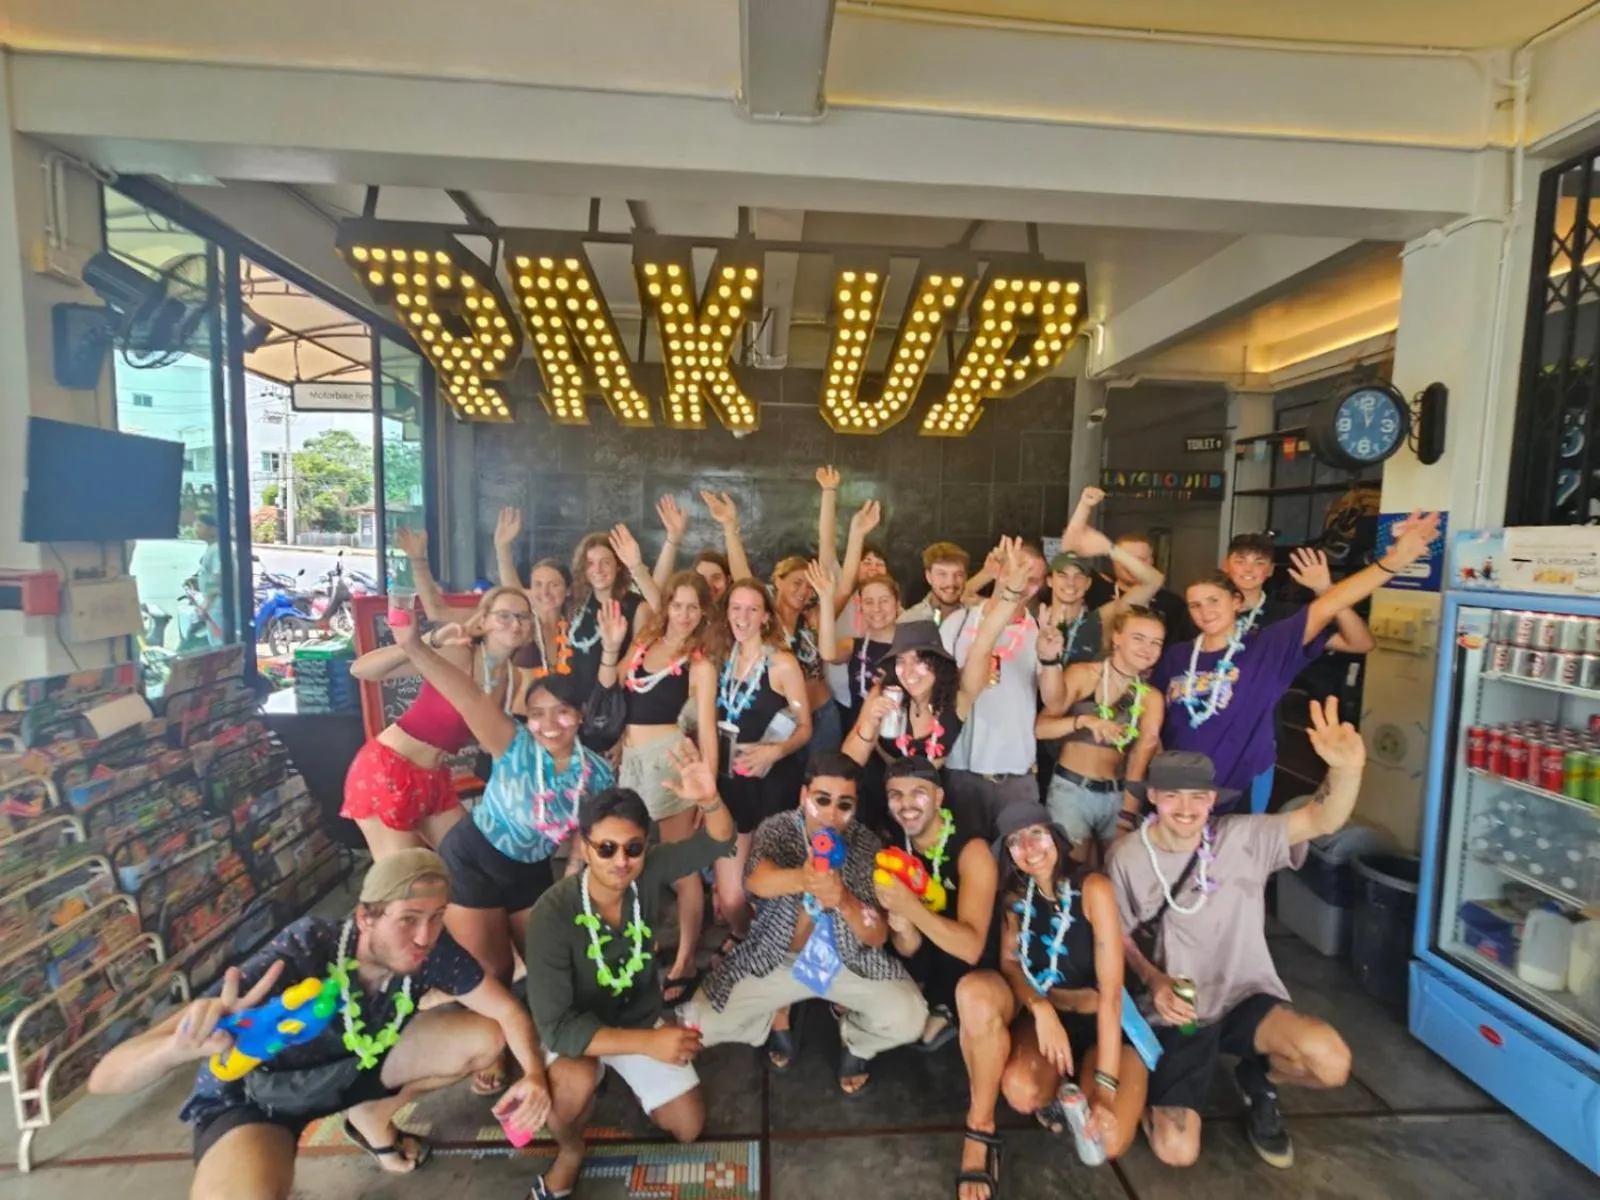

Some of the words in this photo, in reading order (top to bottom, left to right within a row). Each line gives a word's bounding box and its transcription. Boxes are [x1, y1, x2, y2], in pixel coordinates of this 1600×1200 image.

[818, 258, 1089, 437] UP
[1380, 418, 1395, 433] 3
[1103, 471, 1222, 489] LAYGROUND
